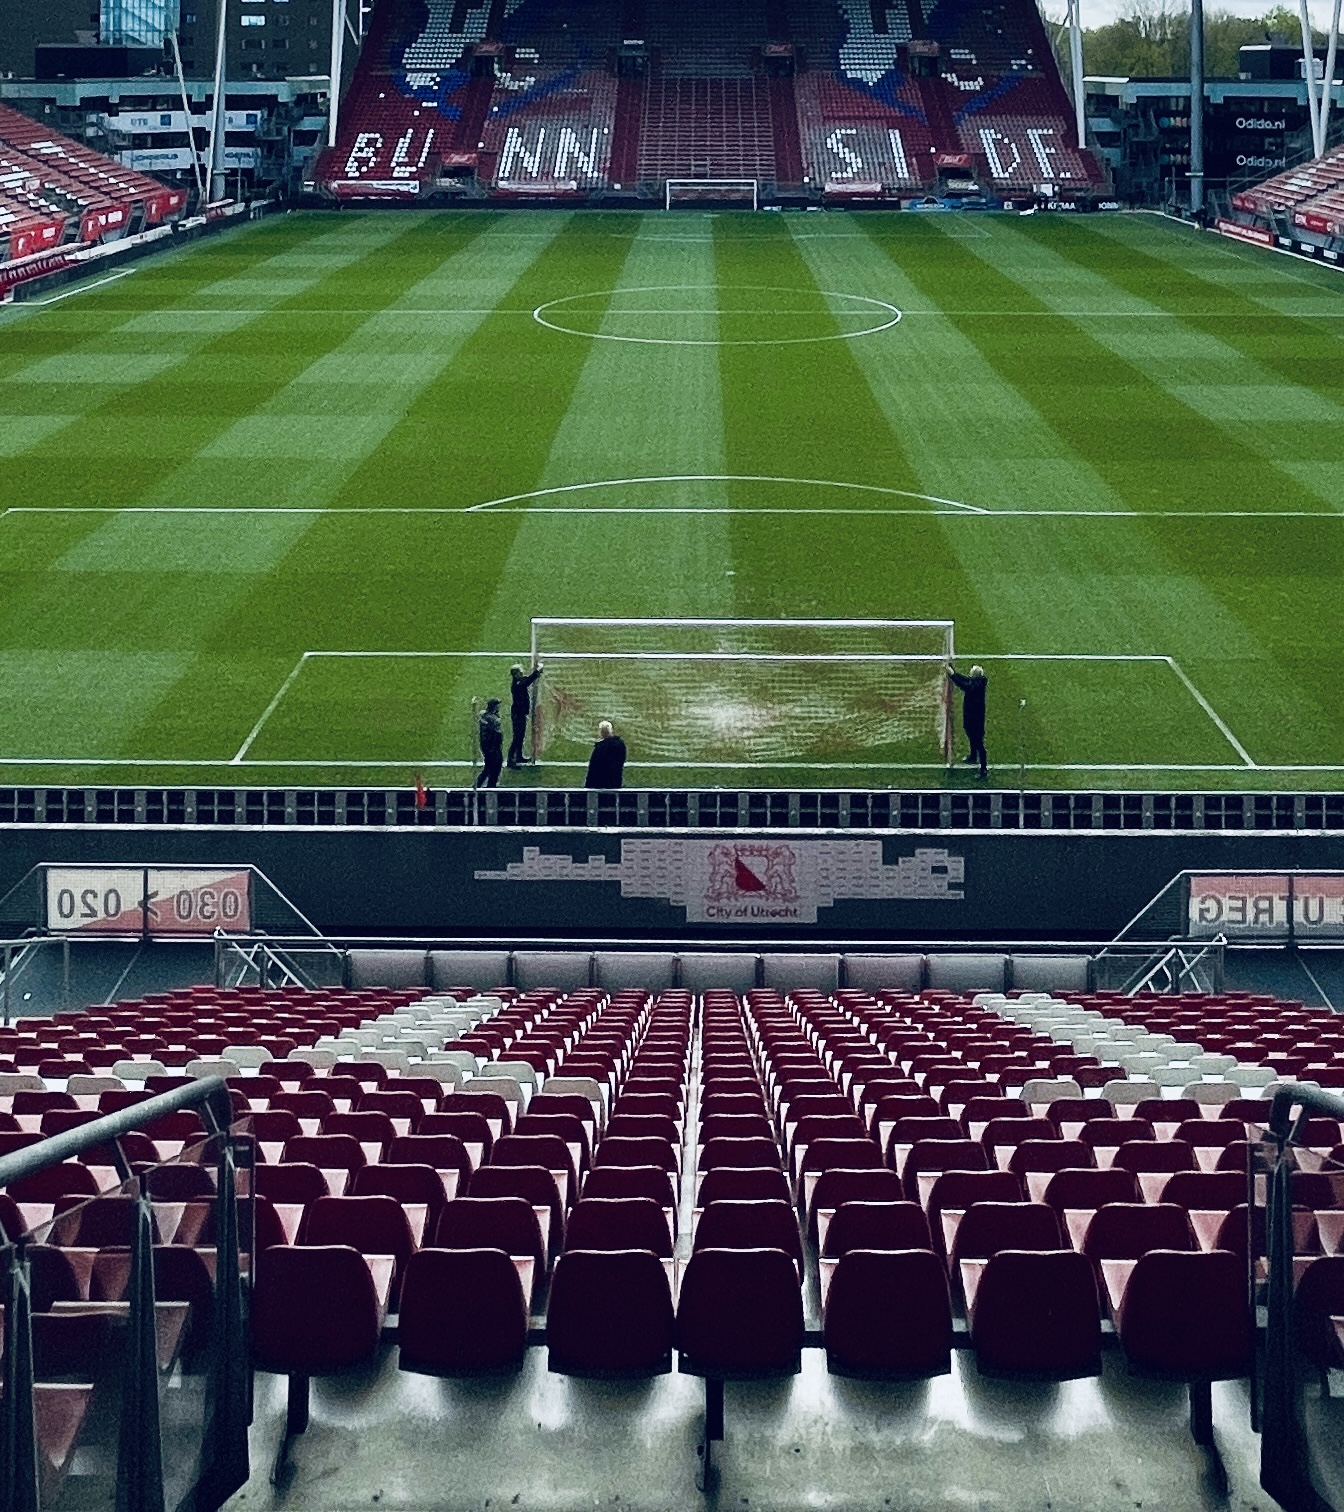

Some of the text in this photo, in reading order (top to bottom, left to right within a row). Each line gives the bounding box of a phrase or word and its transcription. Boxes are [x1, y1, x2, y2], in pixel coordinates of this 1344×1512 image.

[1236, 118, 1285, 129] Odido.nl
[706, 906, 798, 918] City of Utrecht
